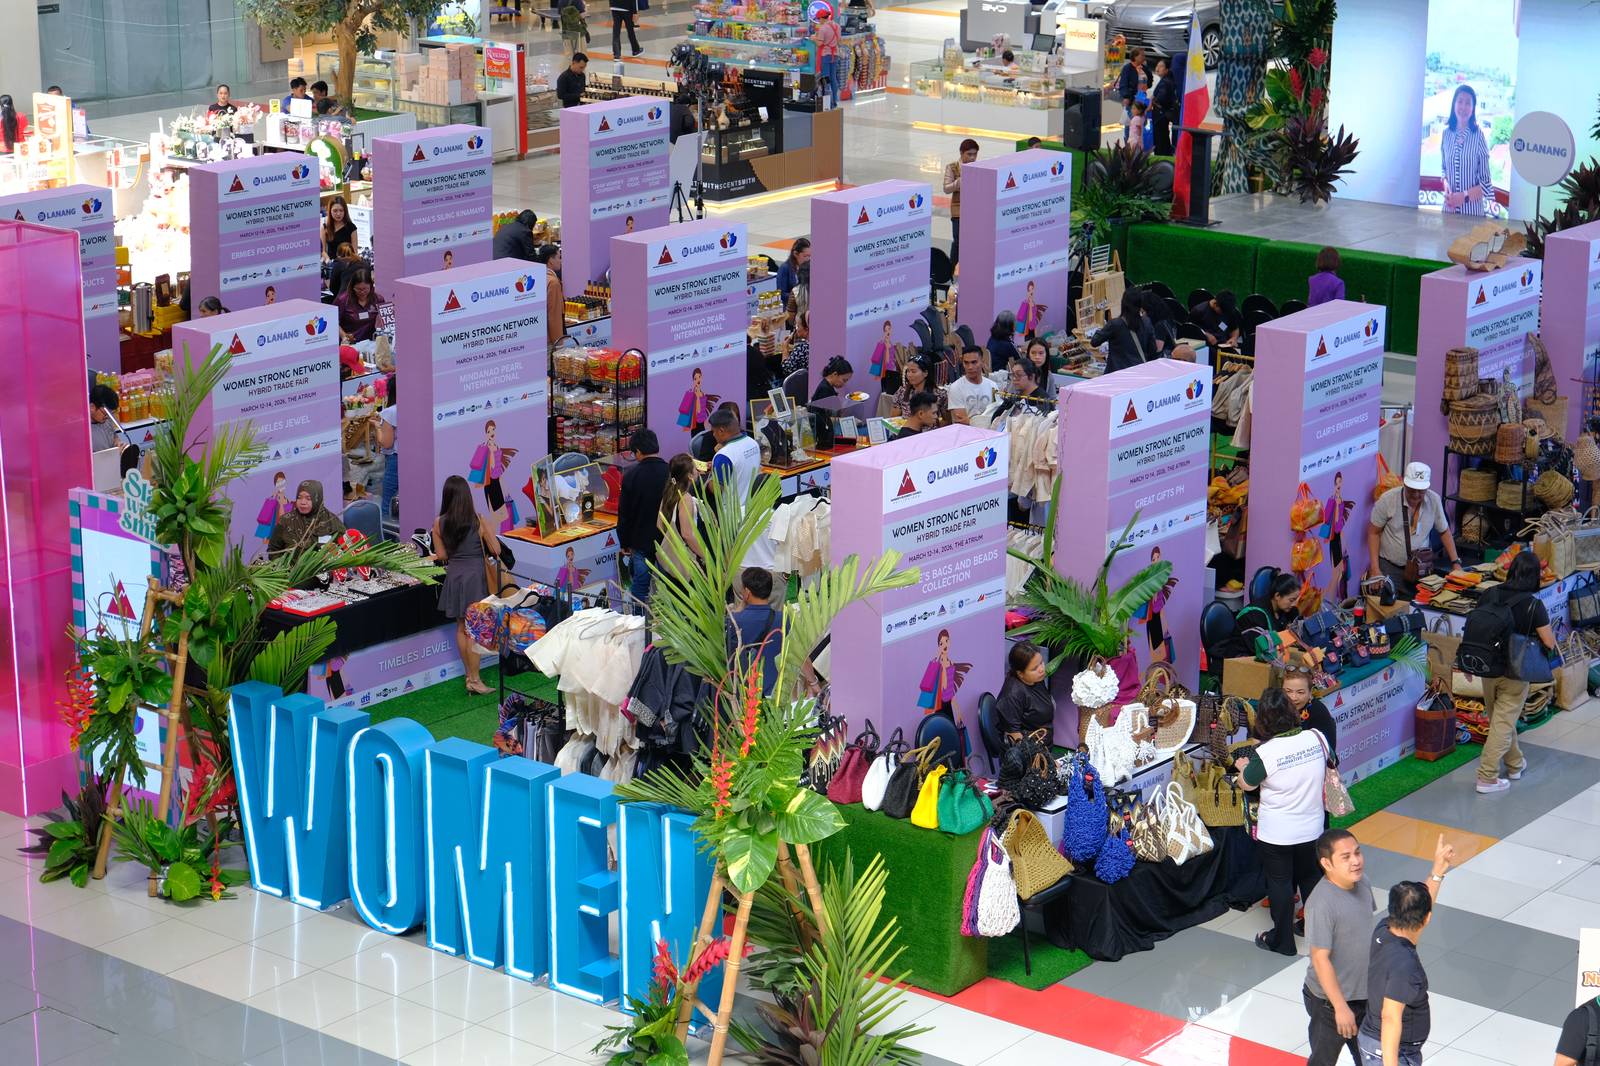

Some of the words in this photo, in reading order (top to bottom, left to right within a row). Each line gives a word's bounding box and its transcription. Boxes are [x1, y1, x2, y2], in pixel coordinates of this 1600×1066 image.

[623, 115, 644, 124] LANANG
[440, 144, 463, 153] LANANG
[596, 149, 616, 157] WOMEN
[618, 144, 638, 153] STRONG
[640, 139, 664, 148] NETWORK
[1527, 143, 1567, 157] LANANG
[261, 174, 286, 183] LANANG
[409, 179, 432, 188] WOMEN
[434, 174, 456, 184] STRONG
[458, 169, 487, 179] NETWORK
[719, 177, 755, 189] SCENTSMITH
[1028, 171, 1047, 181] LANANG
[46, 208, 76, 219] LANANG
[226, 210, 252, 221] WOMEN
[253, 205, 280, 216] STRONG
[282, 200, 313, 211] NETWORK
[884, 204, 905, 215] LANANG
[1002, 207, 1020, 217] WOMEN
[1022, 202, 1041, 212] STRONG
[1042, 196, 1065, 206] NETWORK
[246, 217, 264, 225] HYBRID
[257, 246, 275, 255] FOOD
[277, 239, 310, 251] PRODUCTS
[690, 243, 714, 255] LANANG
[854, 243, 875, 254] WOMEN
[876, 236, 898, 249] STRONG
[899, 230, 925, 242] NETWORK
[870, 249, 885, 257] HYBRID
[480, 287, 509, 299] LANANG
[655, 285, 680, 296] WOMEN
[682, 278, 707, 291] STRONG
[709, 271, 740, 284] NETWORK
[674, 292, 692, 301] HYBRID
[693, 289, 709, 297] TRADE
[711, 285, 721, 293] FAIR
[1499, 281, 1517, 293] LANANG
[712, 298, 727, 306] ATRIUM
[440, 332, 470, 344] WOMEN
[472, 324, 501, 338] STRONG
[503, 316, 539, 330] NETWORK
[671, 318, 705, 333] MINDANAO
[707, 313, 726, 324] PEARL
[674, 324, 724, 340] INTERNATIONAL
[1471, 324, 1489, 337] WOMEN
[1490, 318, 1509, 331] STRONG
[1511, 310, 1533, 324] NETWORK
[267, 330, 299, 344] LANANG
[463, 339, 485, 349] HYBRID
[486, 335, 504, 344] TRADE
[506, 332, 518, 341] FAIR
[1340, 331, 1360, 345] LANANG
[456, 357, 472, 365] MARCH
[508, 345, 524, 353] ATRIUM
[223, 378, 256, 391] WOMEN
[258, 370, 290, 384] STRONG
[293, 361, 332, 376] NETWORK
[460, 367, 499, 384] MINDANAO
[501, 362, 522, 373] PEARL
[463, 372, 520, 392] INTERNATIONAL
[1311, 378, 1331, 392] WOMEN
[1332, 370, 1352, 385] STRONG
[1354, 362, 1378, 378] NETWORK
[249, 386, 272, 397] HYBRID
[274, 381, 293, 391] TRADE
[296, 377, 309, 387] FAIR
[1325, 386, 1340, 397] HYBRID
[1341, 382, 1354, 392] TRADE
[1355, 378, 1363, 388] FAIR
[241, 405, 258, 414] MARCH
[298, 392, 316, 401] ATRIUM
[1154, 394, 1181, 409] LANANG
[285, 416, 311, 429] JEWEL
[1336, 412, 1368, 432] ENTERPRISES
[1118, 446, 1144, 461] WOMEN
[1145, 437, 1172, 452] STRONG
[1173, 426, 1204, 443] NETWORK
[1137, 455, 1155, 467] HYBRID
[1157, 450, 1173, 461] TRADE
[1174, 445, 1185, 456] FAIR
[937, 463, 968, 480] LANANG
[1130, 475, 1144, 484] MARCH
[1176, 460, 1190, 470] ATRIUM
[1135, 495, 1155, 509] GREAT
[1157, 487, 1175, 502] GIFTS
[1176, 485, 1185, 495] PH
[893, 522, 924, 539] WOMEN
[926, 511, 959, 529] STRONG
[961, 498, 1000, 518] NETWORK
[917, 530, 939, 543] HYBRID
[942, 524, 961, 536] TRADE
[963, 518, 976, 530] FAIR
[909, 551, 926, 562] MARCH
[927, 548, 941, 558] 12-14,
[942, 544, 953, 553] 2026,
[955, 541, 964, 549] THE
[965, 535, 983, 546] ATRIUM
[595, 552, 616, 565] WOME
[932, 564, 952, 579] BAGS
[955, 558, 971, 571] AND
[973, 549, 998, 566] BEADS
[922, 570, 971, 594] COLLECTION
[378, 651, 418, 672] TIMELES
[421, 641, 451, 659] JEWEL
[1350, 700, 1374, 717] STRONG
[1376, 684, 1405, 704] NETWORK
[1361, 711, 1375, 721] TRADE
[1376, 705, 1386, 715] FAIR
[1340, 744, 1358, 760] REAT
[1360, 733, 1378, 751] GIFTS
[1381, 728, 1391, 738] PH
[1277, 756, 1301, 767] INNOVATIVE
[228, 680, 722, 1030] WOMEN
